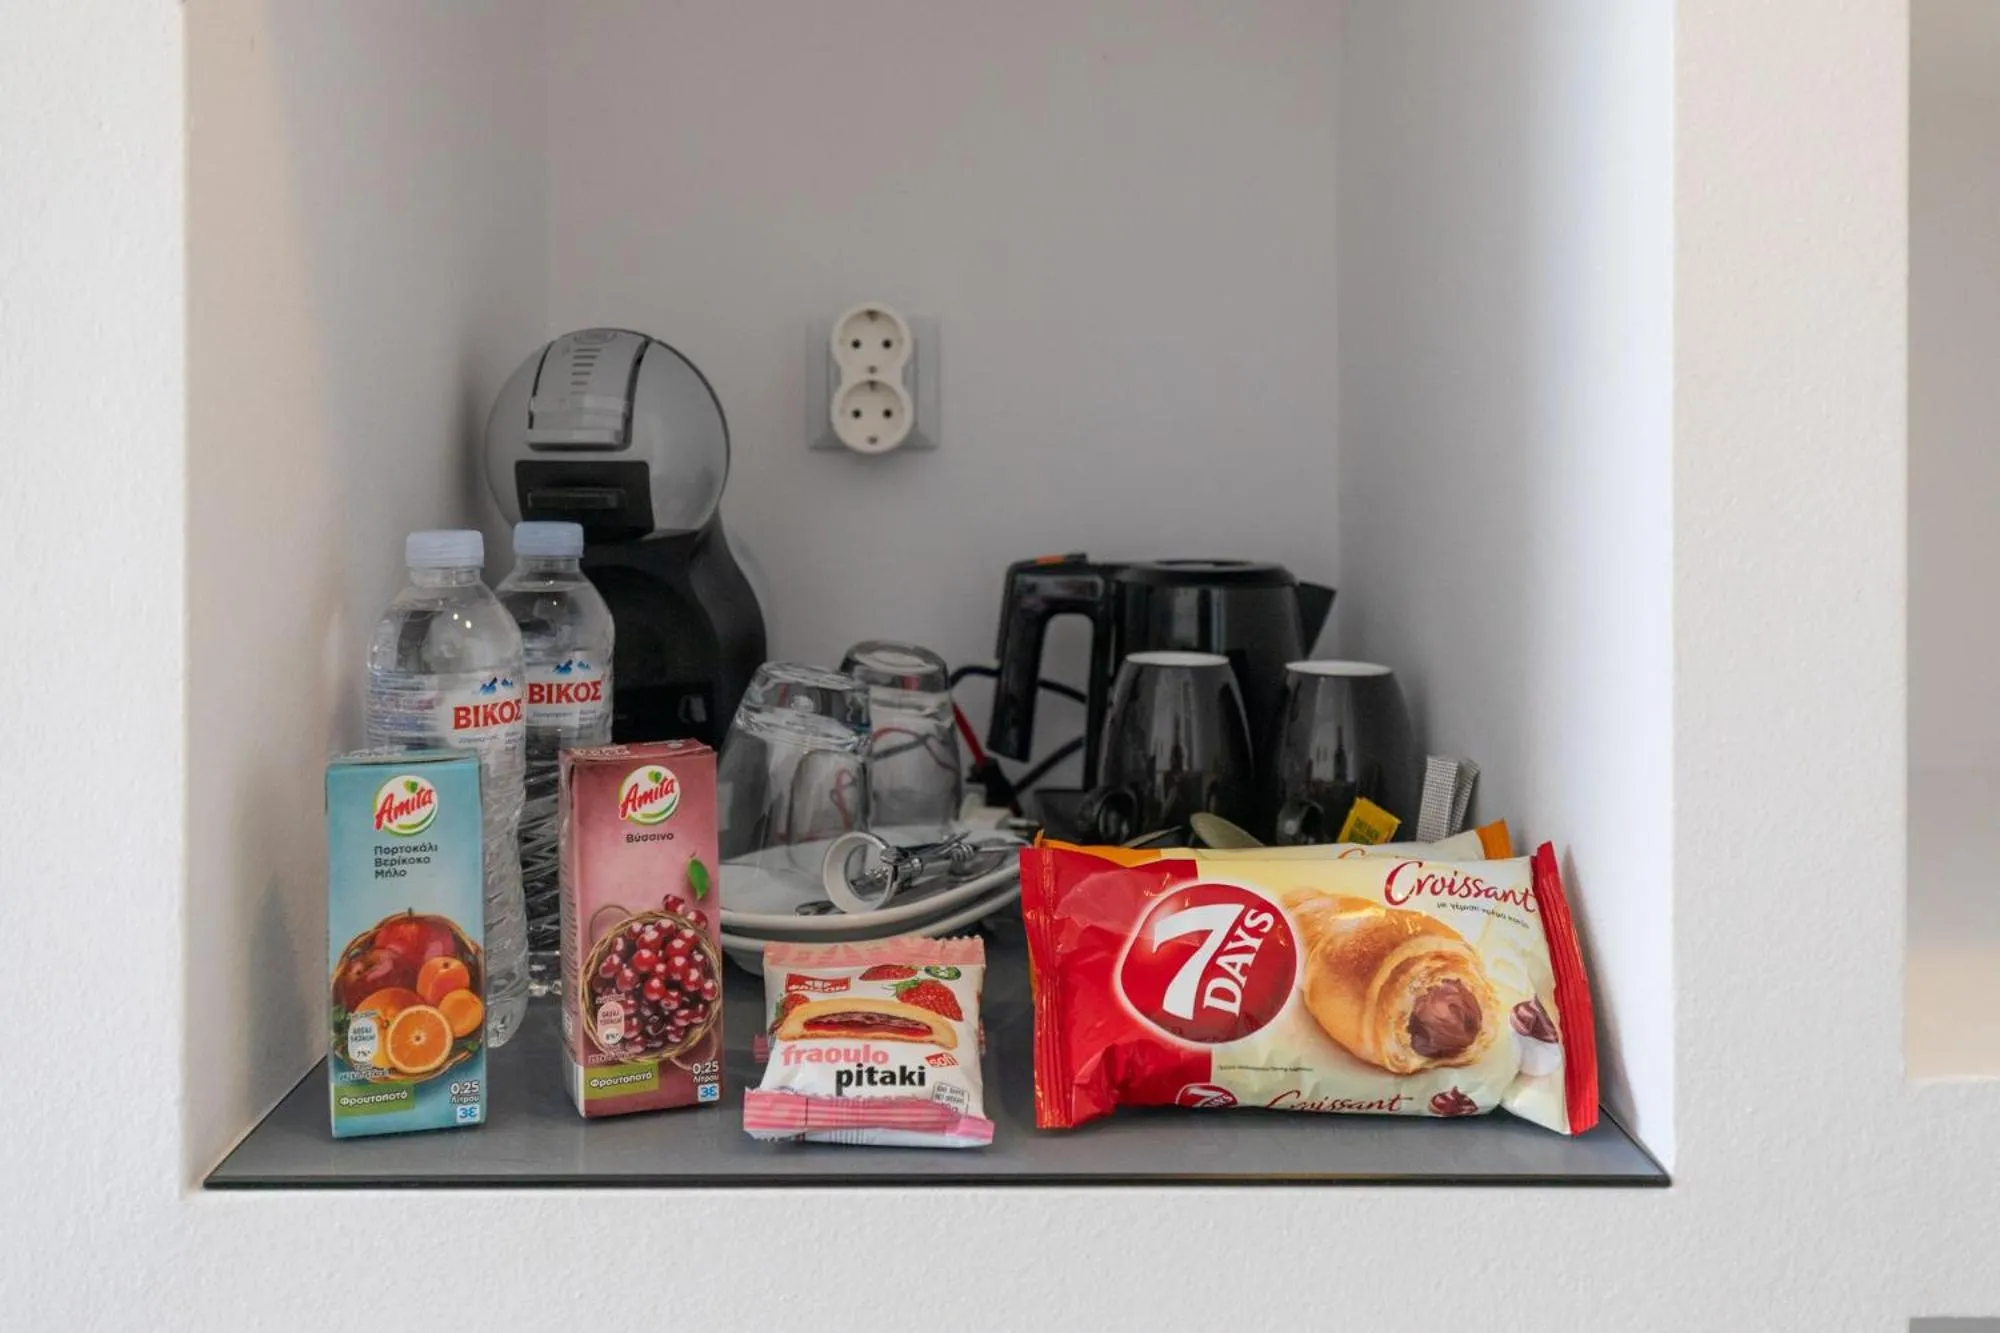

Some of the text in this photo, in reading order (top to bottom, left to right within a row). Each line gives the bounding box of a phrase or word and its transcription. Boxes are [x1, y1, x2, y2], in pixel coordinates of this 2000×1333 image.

[528, 680, 603, 705] ΒΙΚΟΣ
[374, 786, 435, 831] Amita
[620, 776, 676, 819] Amita
[374, 843, 438, 857] Πορτοκάλι
[626, 832, 674, 843] Βύσσινο
[374, 856, 431, 868] Βερίκοκο
[375, 868, 407, 880] Μήλο
[1384, 860, 1537, 913] Croissant
[1152, 903, 1275, 1021] 7 DAYS
[782, 1044, 889, 1066] fraoulo
[836, 1063, 926, 1097] pitaki
